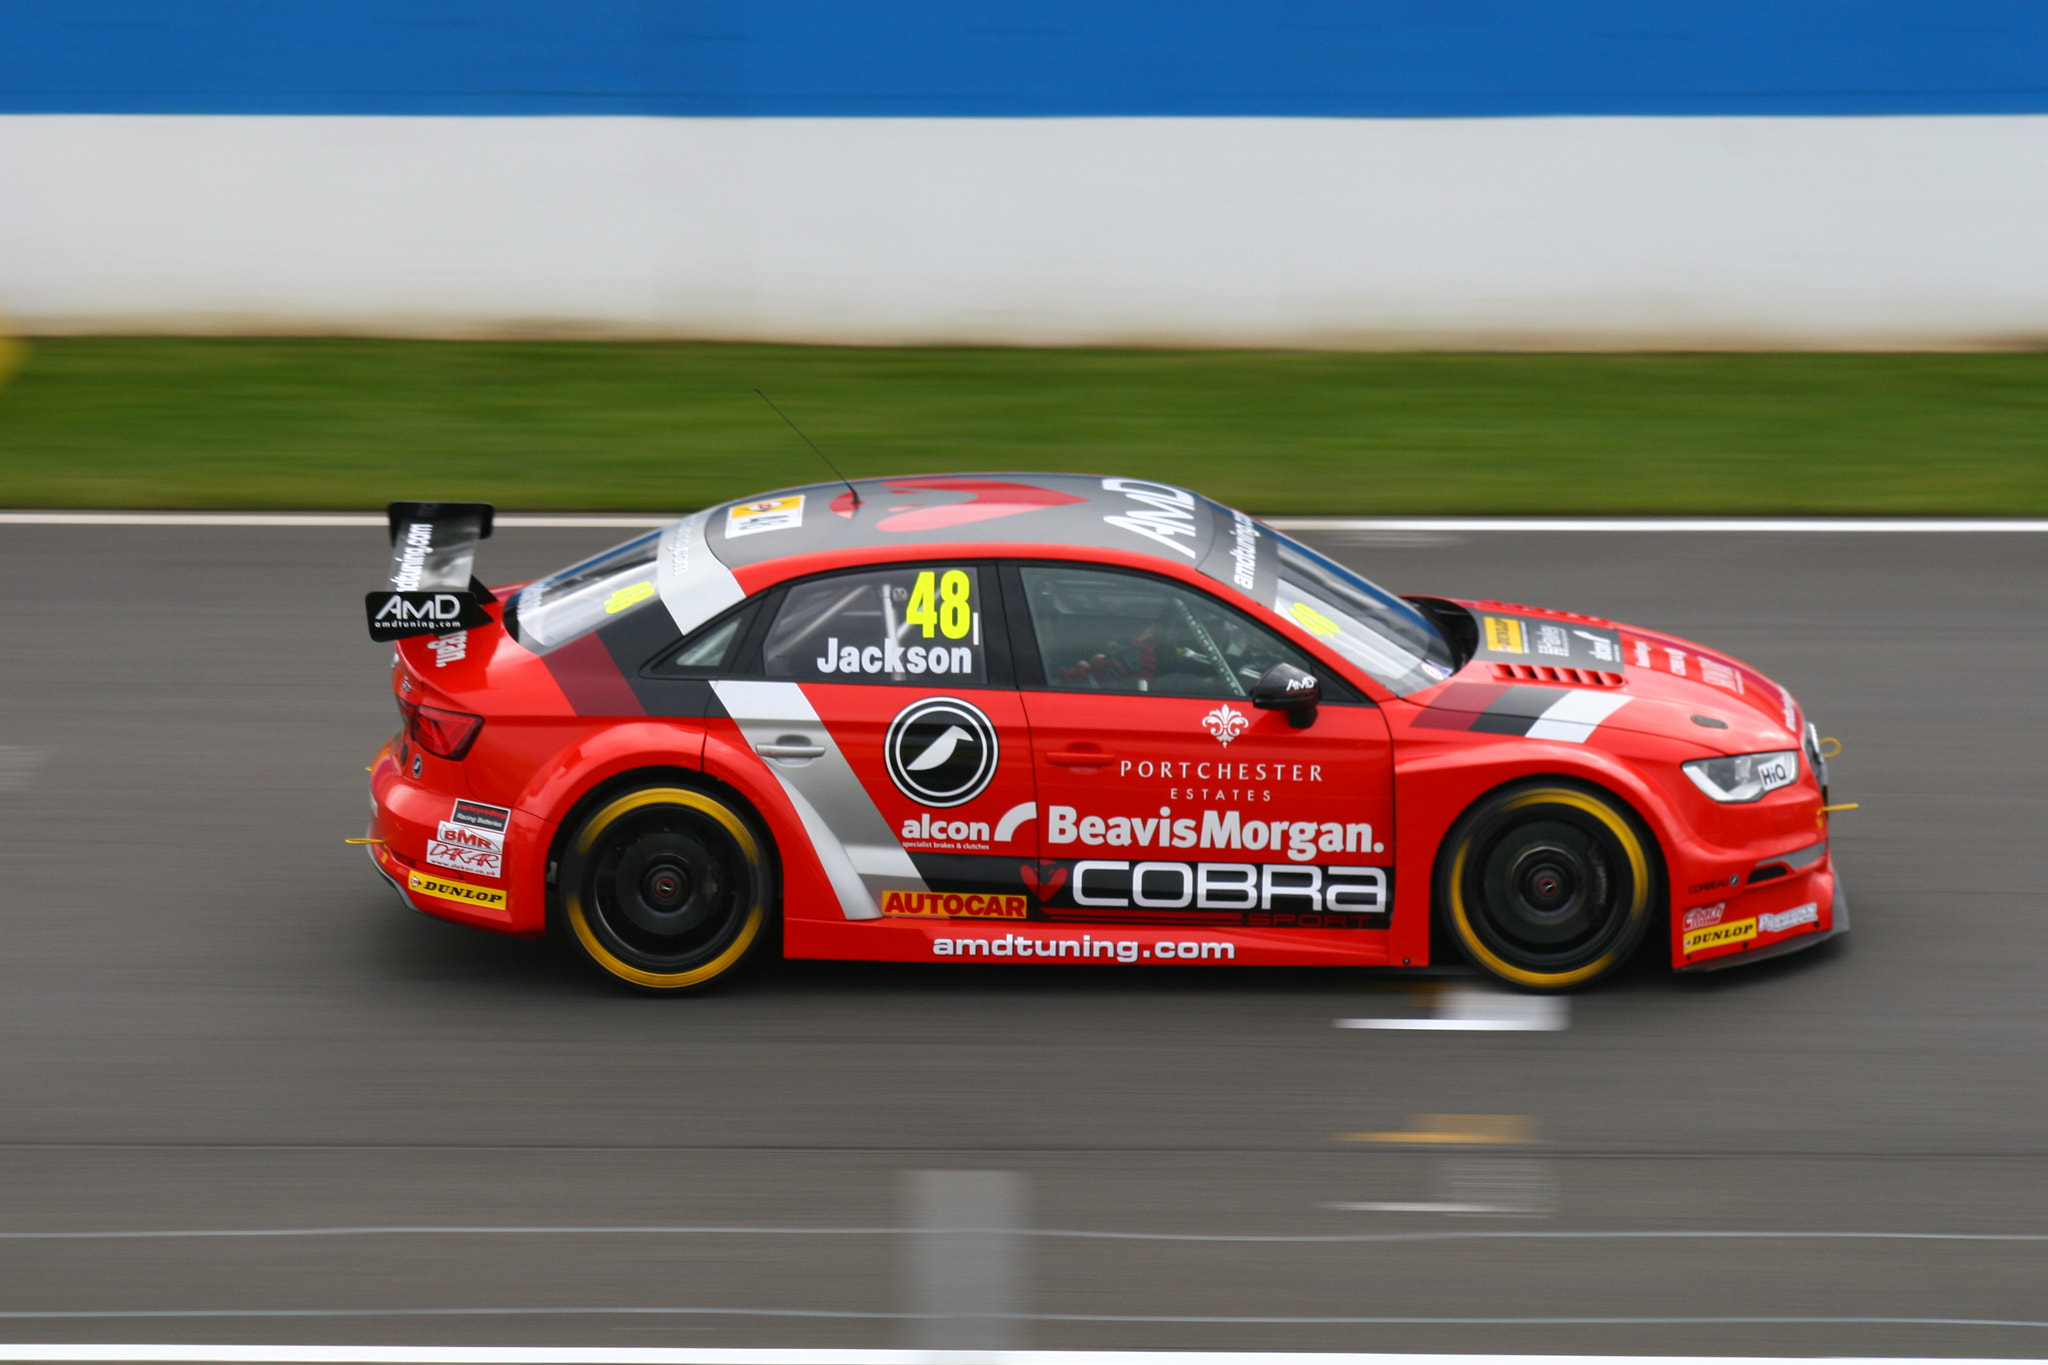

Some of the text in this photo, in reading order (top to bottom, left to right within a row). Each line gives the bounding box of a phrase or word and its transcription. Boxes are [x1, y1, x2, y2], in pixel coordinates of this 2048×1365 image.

[906, 569, 971, 640] 48
[374, 620, 461, 629] amdtuning.com
[816, 637, 972, 674] Jackson
[1119, 760, 1323, 782] PORTCHESTER
[1760, 763, 1788, 786] HiQ
[1170, 788, 1271, 802] ESTATES
[444, 829, 493, 850] BMR
[901, 813, 990, 842] alcon
[1048, 805, 1385, 861] BeavisMorgan.
[430, 843, 500, 869] DAKAR
[424, 881, 503, 903] DUNLOP
[883, 893, 1025, 917] AUTOCAR
[1247, 914, 1373, 929] SPORT
[1692, 923, 1754, 947] DUNLOP
[933, 933, 1235, 962] amdtuning.com
